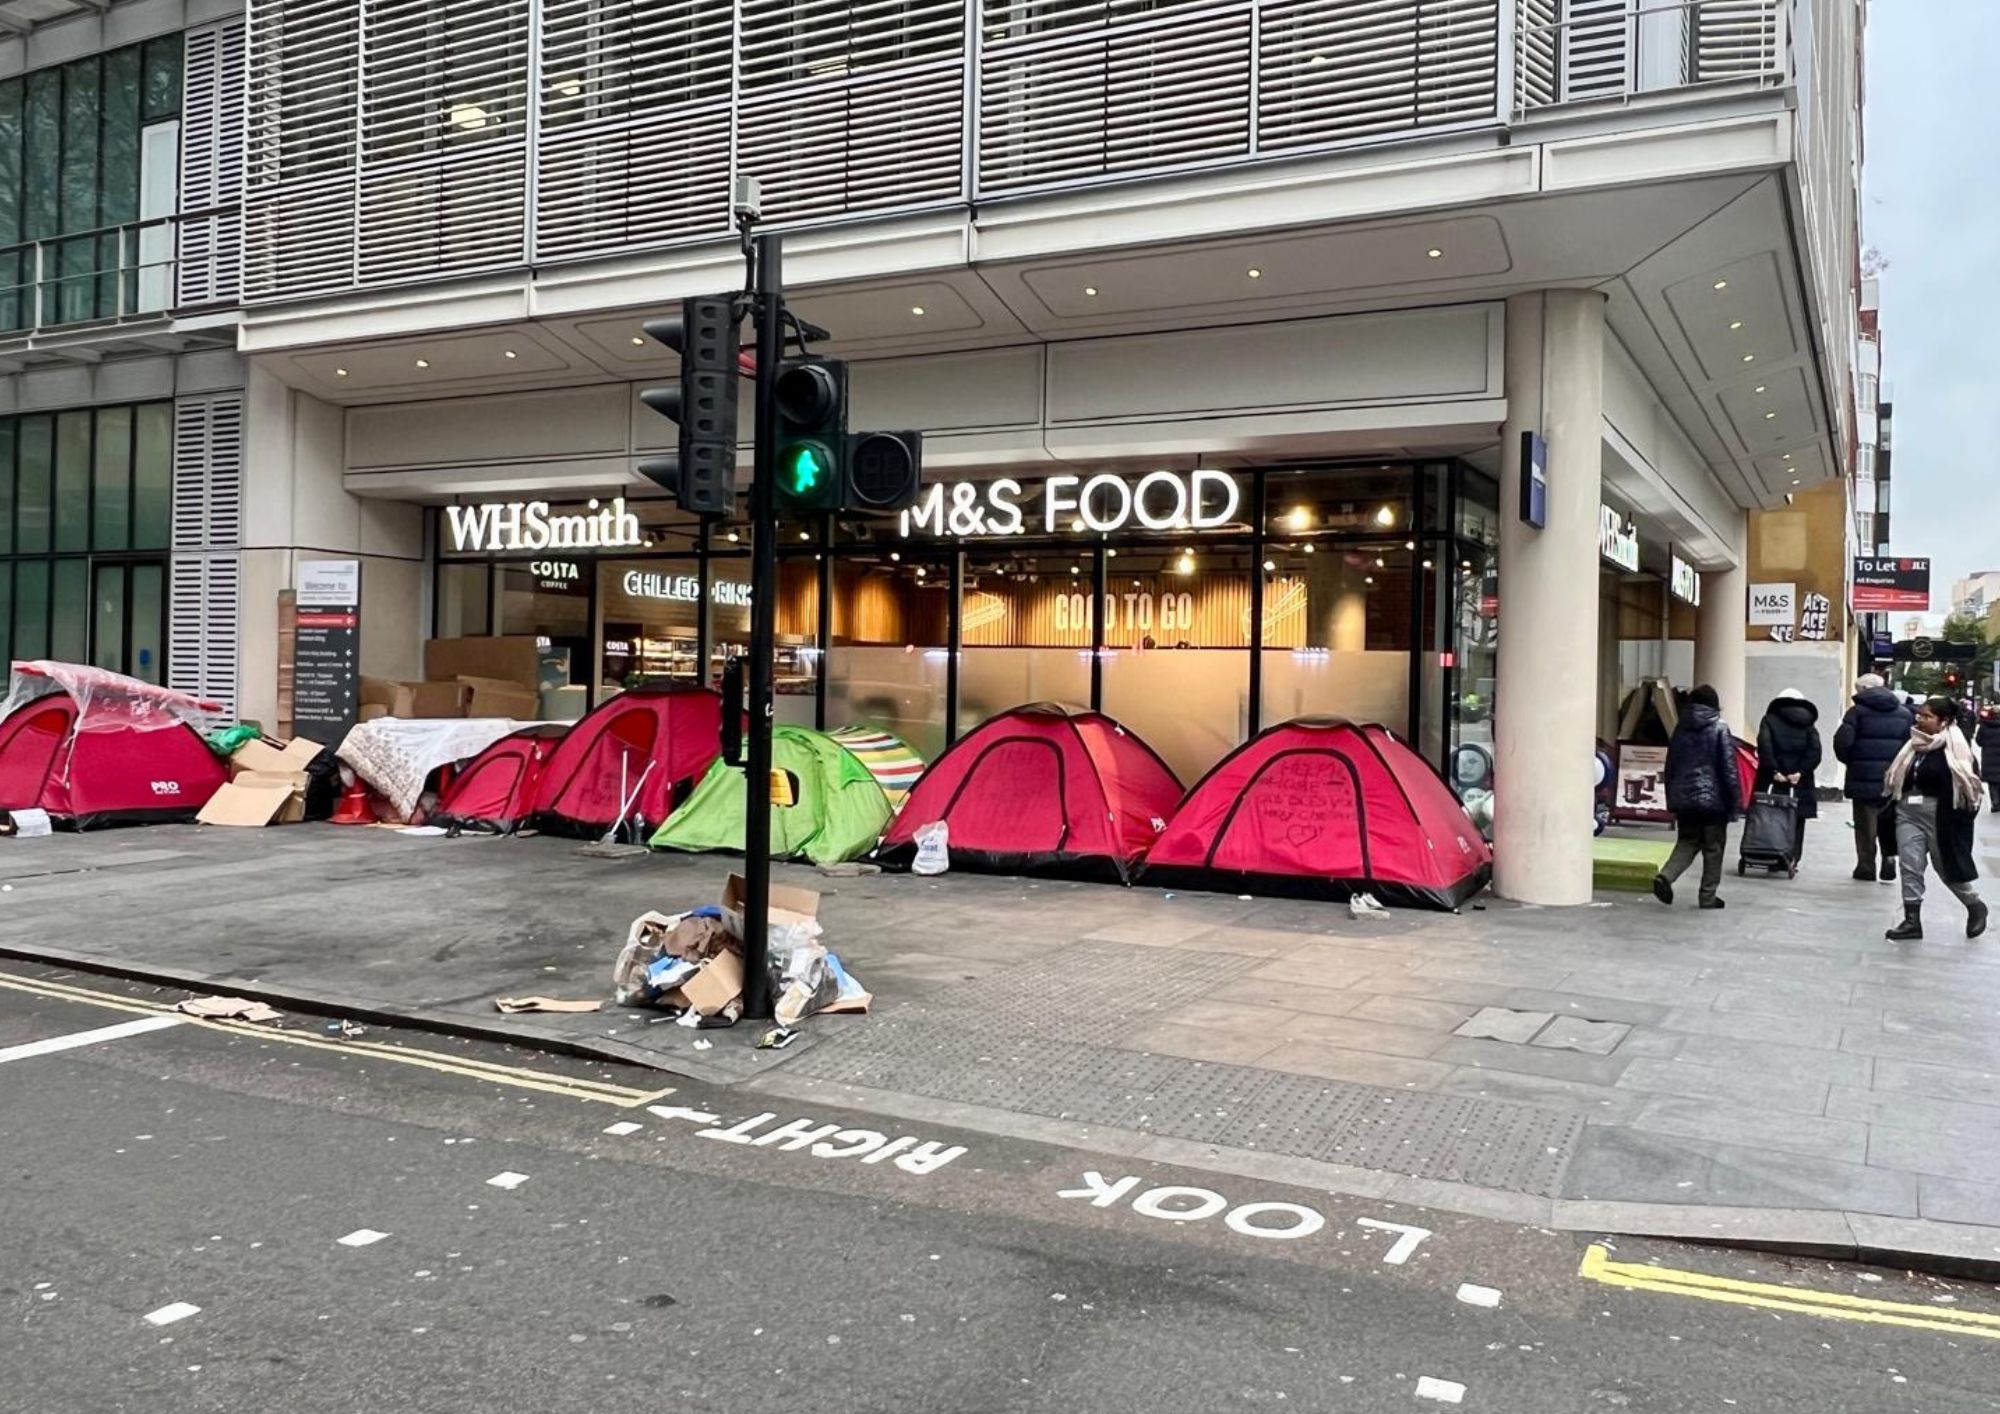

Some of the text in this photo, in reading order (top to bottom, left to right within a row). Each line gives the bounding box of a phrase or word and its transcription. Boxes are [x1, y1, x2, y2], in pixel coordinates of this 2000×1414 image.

[900, 470, 1239, 537] M&S FOOD
[446, 498, 641, 551] WHSmith
[530, 561, 579, 579] COSTA
[1857, 560, 1896, 572] To Let
[623, 570, 753, 606] CHILLED RINK
[1754, 595, 1789, 608] M&S
[1803, 593, 1828, 611] ACE
[1055, 593, 1193, 632] GOOD TO GO
[1801, 611, 1826, 629] ACE
[536, 636, 551, 647] STA
[605, 641, 629, 651] COSTA
[695, 1113, 1433, 1265] LOOK RIGHT
